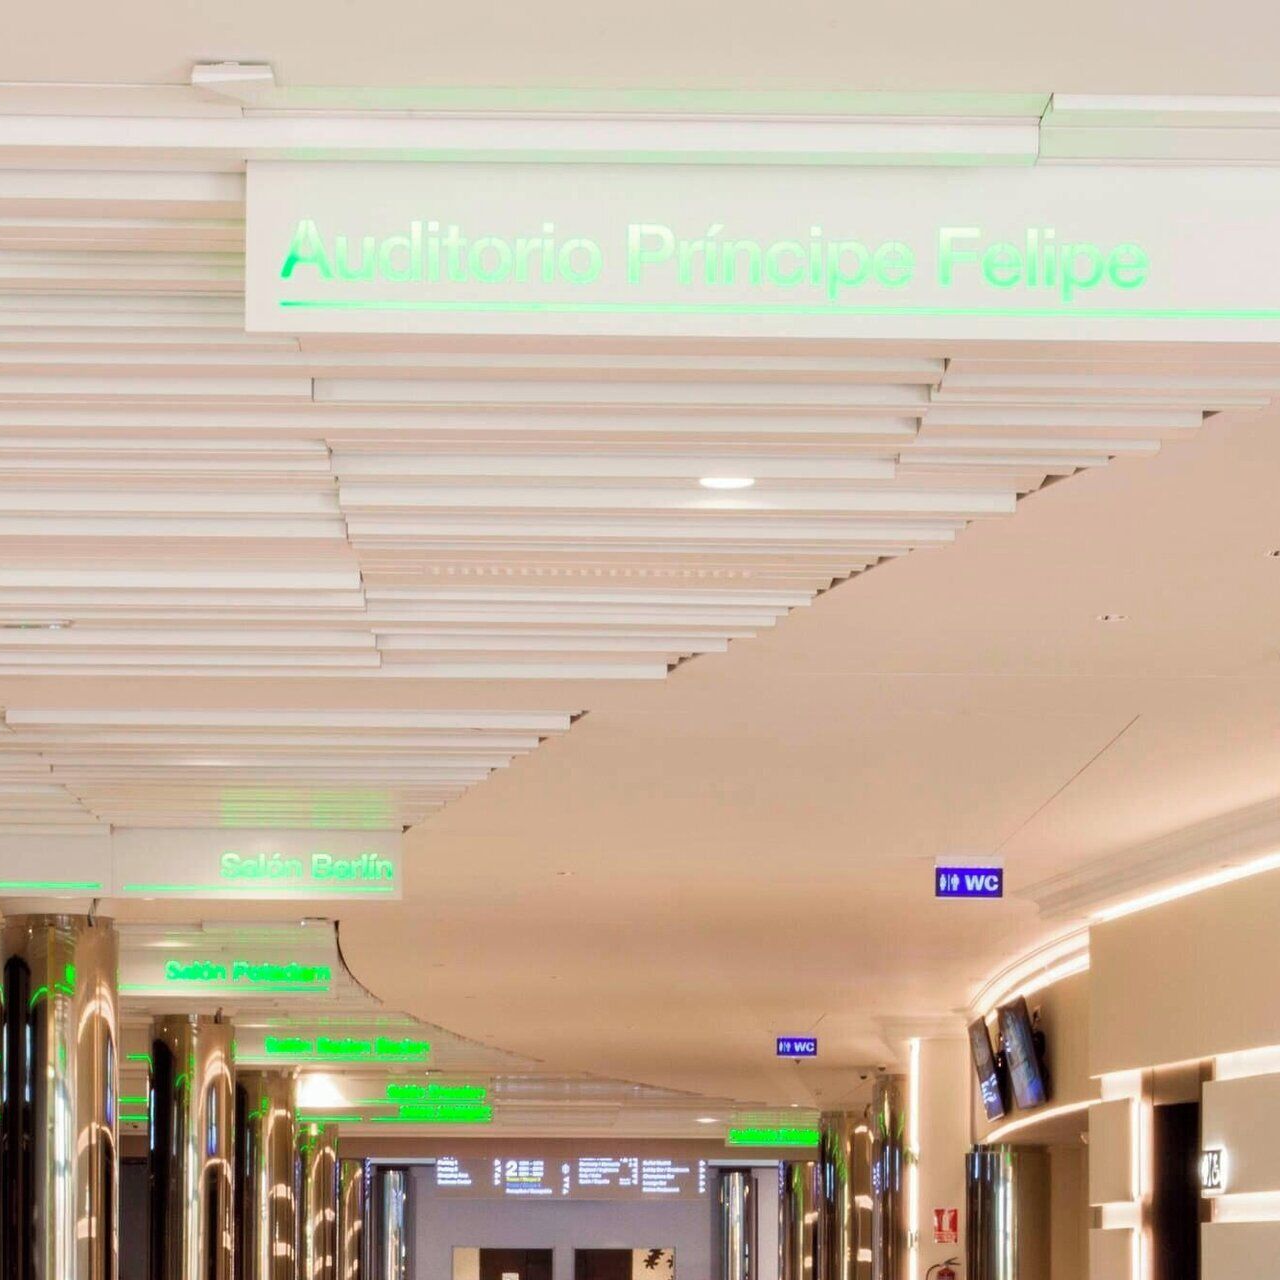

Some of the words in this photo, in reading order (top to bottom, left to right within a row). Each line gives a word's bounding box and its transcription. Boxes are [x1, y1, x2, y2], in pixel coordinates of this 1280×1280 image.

[279, 218, 604, 284] Auditorio
[626, 222, 917, 300] Príncipe
[936, 225, 1151, 302] Felipe
[220, 851, 303, 881] Salón
[311, 852, 394, 881] Berlín
[964, 874, 999, 891] WC
[793, 1041, 815, 1053] WC
[505, 1160, 518, 1177] 2
